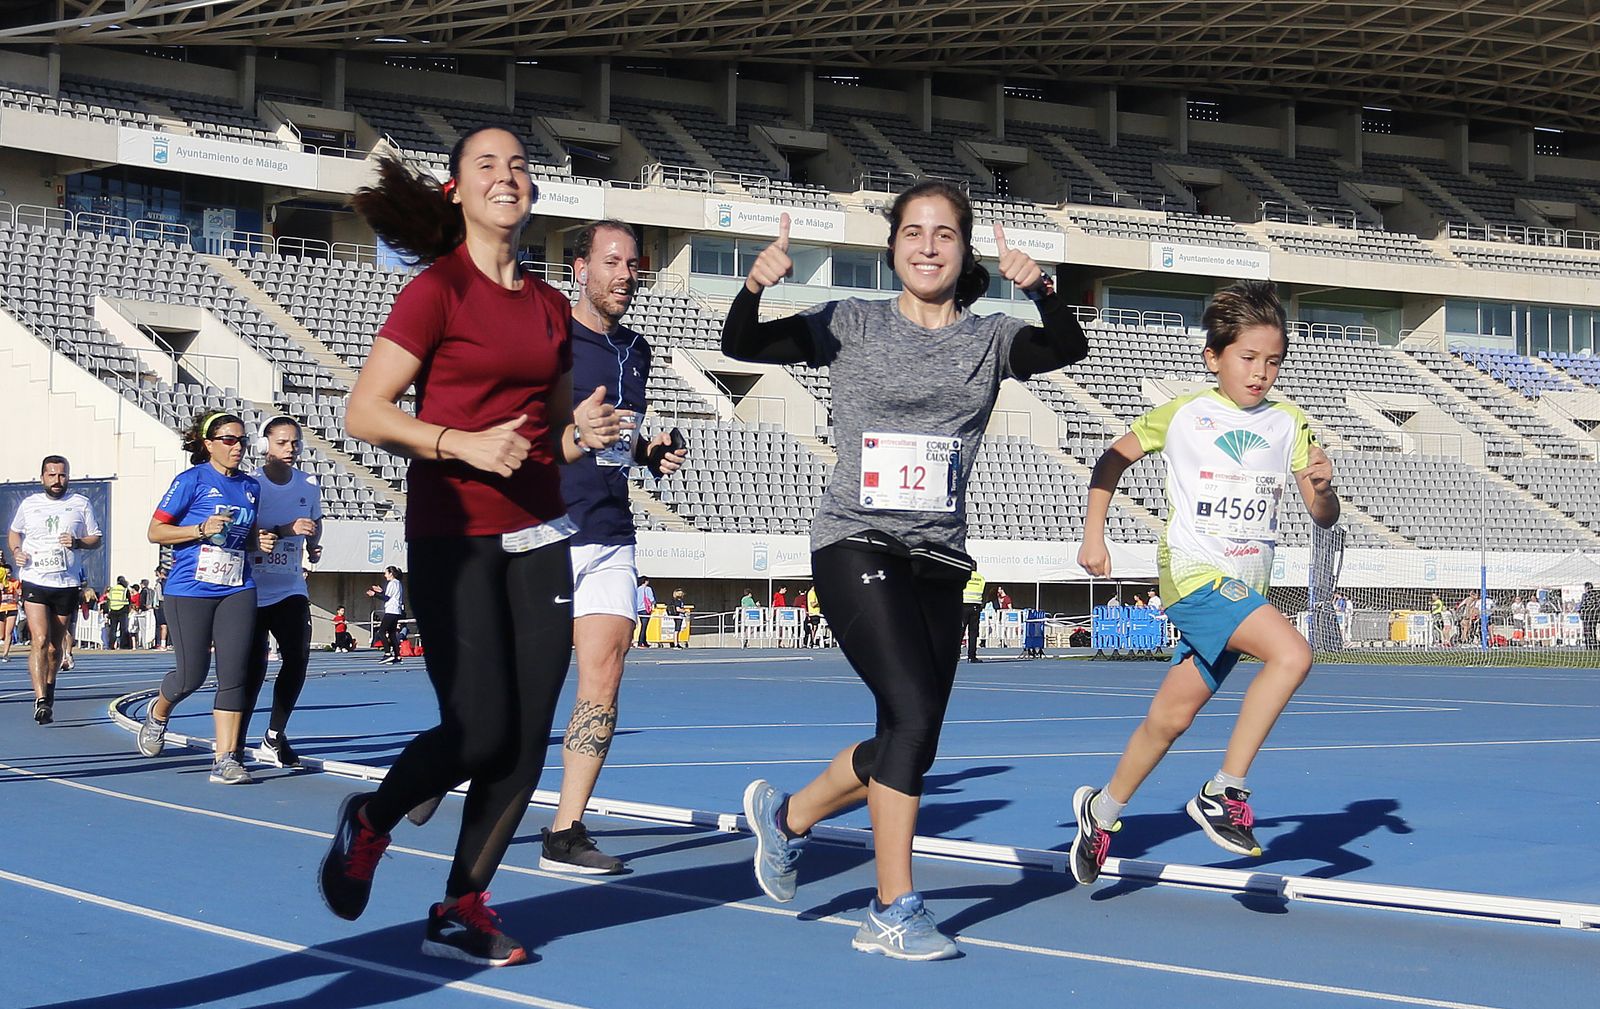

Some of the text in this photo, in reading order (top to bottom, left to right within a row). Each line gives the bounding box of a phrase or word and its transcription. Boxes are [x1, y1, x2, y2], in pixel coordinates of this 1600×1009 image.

[175, 146, 289, 172] Ayuntamiento de Málaga
[549, 192, 580, 205] Málaga
[794, 218, 804, 226] de
[805, 218, 834, 231] Málaga
[1017, 239, 1027, 247] de
[1028, 239, 1054, 250] Málaga
[1178, 253, 1260, 269] Ayuntamiento de Málaga
[899, 465, 926, 490] 12
[1214, 497, 1267, 522] 4569
[267, 553, 288, 566] 383
[656, 547, 668, 558] de
[671, 547, 706, 560] Málaga
[1023, 556, 1034, 564] de
[39, 556, 60, 567] 4568
[212, 561, 234, 576] 347
